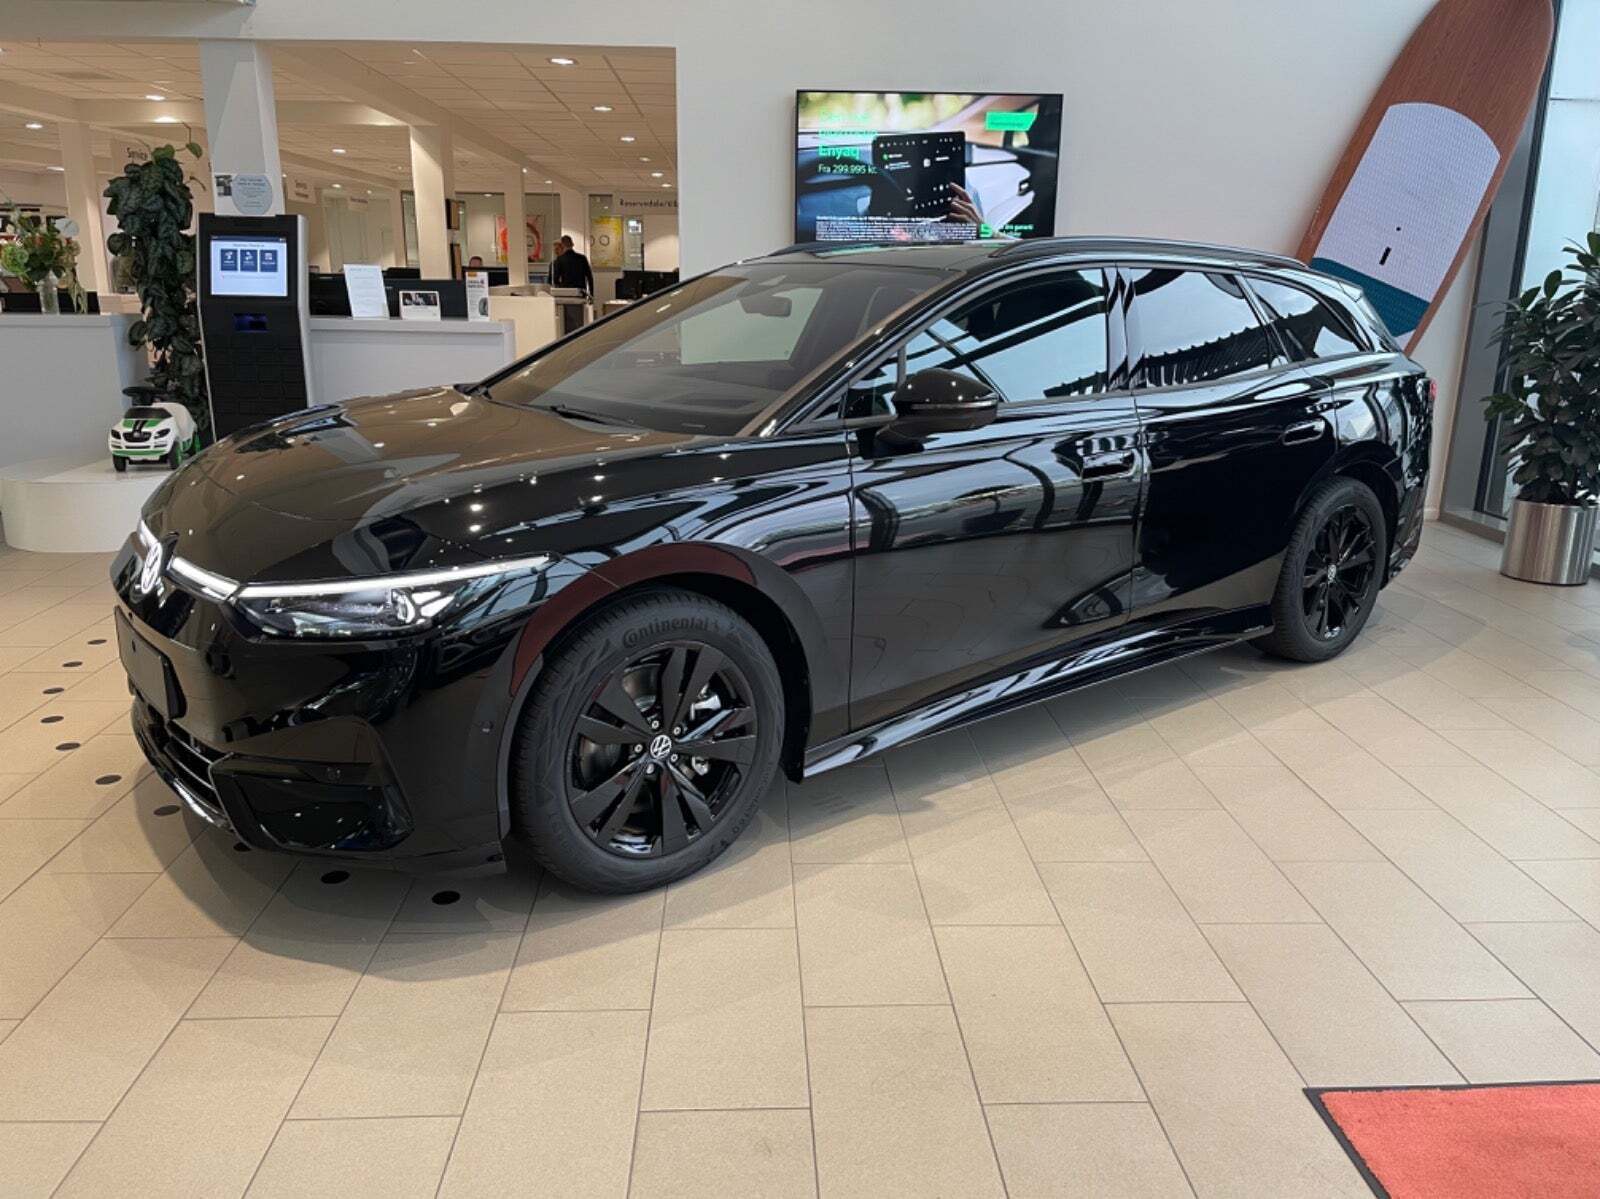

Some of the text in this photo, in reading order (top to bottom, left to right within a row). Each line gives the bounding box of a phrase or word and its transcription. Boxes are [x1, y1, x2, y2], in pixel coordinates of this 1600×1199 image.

[818, 145, 860, 161] Enyaq
[818, 163, 832, 173] Fra
[623, 617, 708, 648] Continental
